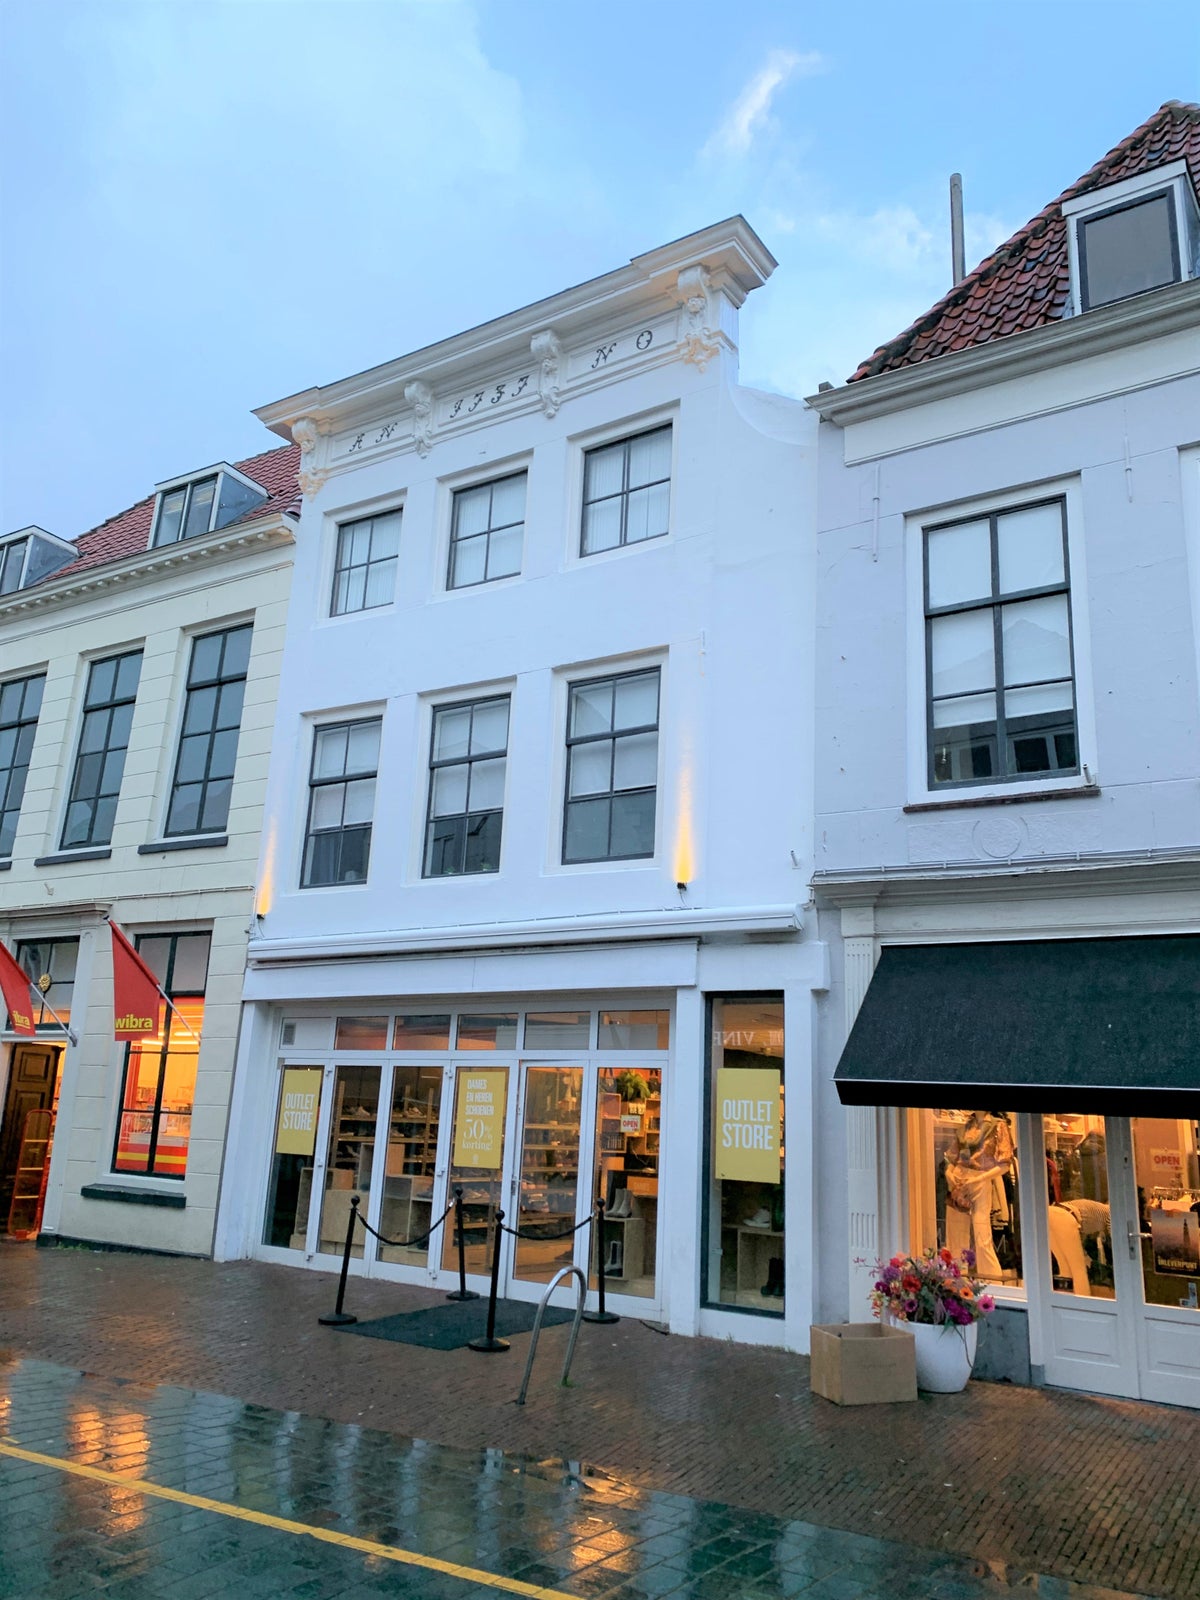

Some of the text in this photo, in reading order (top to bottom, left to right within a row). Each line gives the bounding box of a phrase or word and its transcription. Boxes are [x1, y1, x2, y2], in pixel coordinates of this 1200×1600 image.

[115, 1014, 152, 1029] wibra
[467, 1079, 487, 1090] DAMES
[285, 1093, 315, 1110] OUTLET
[723, 1099, 774, 1122] OUTLET
[282, 1110, 313, 1131] STORE
[623, 1120, 638, 1128] OPEN
[722, 1122, 774, 1151] STORE
[1154, 1155, 1180, 1166] OPEN
